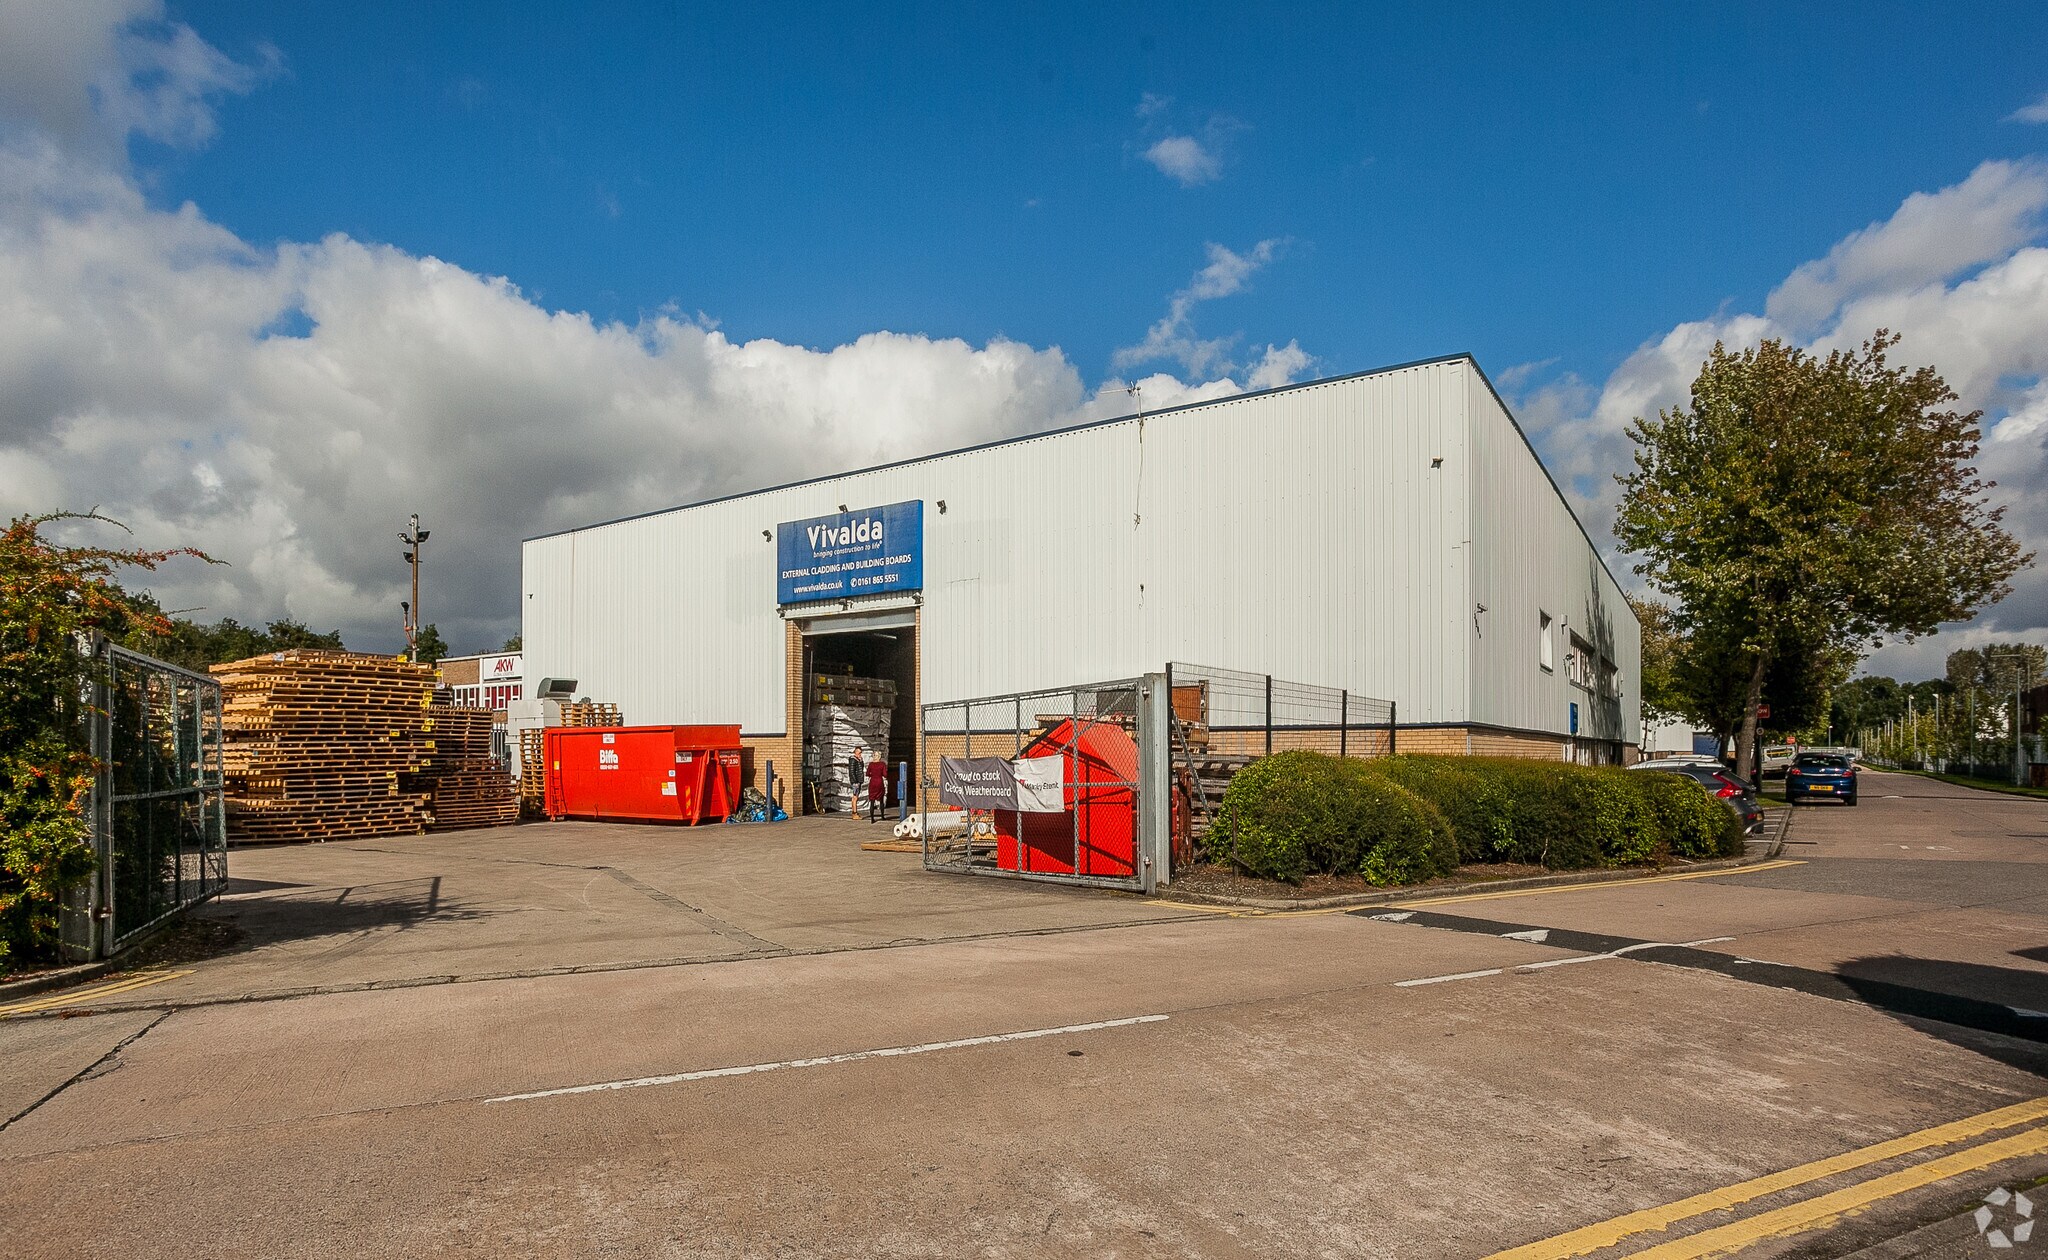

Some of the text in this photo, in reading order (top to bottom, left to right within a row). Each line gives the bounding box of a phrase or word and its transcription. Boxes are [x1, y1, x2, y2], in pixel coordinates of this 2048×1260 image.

[806, 517, 883, 550] Vivalda
[813, 550, 833, 559] bringing
[834, 545, 864, 555] construction
[782, 554, 912, 579] EXTERNAL CLADDING AND BUILDING BOARDS
[793, 573, 899, 594] www.vivalda.co.uk 0161 865 5551
[494, 658, 514, 672] AKW
[600, 749, 619, 764] Biffa
[973, 771, 981, 781] to
[982, 770, 1001, 781] stock
[964, 785, 1012, 797] Weatherboard
